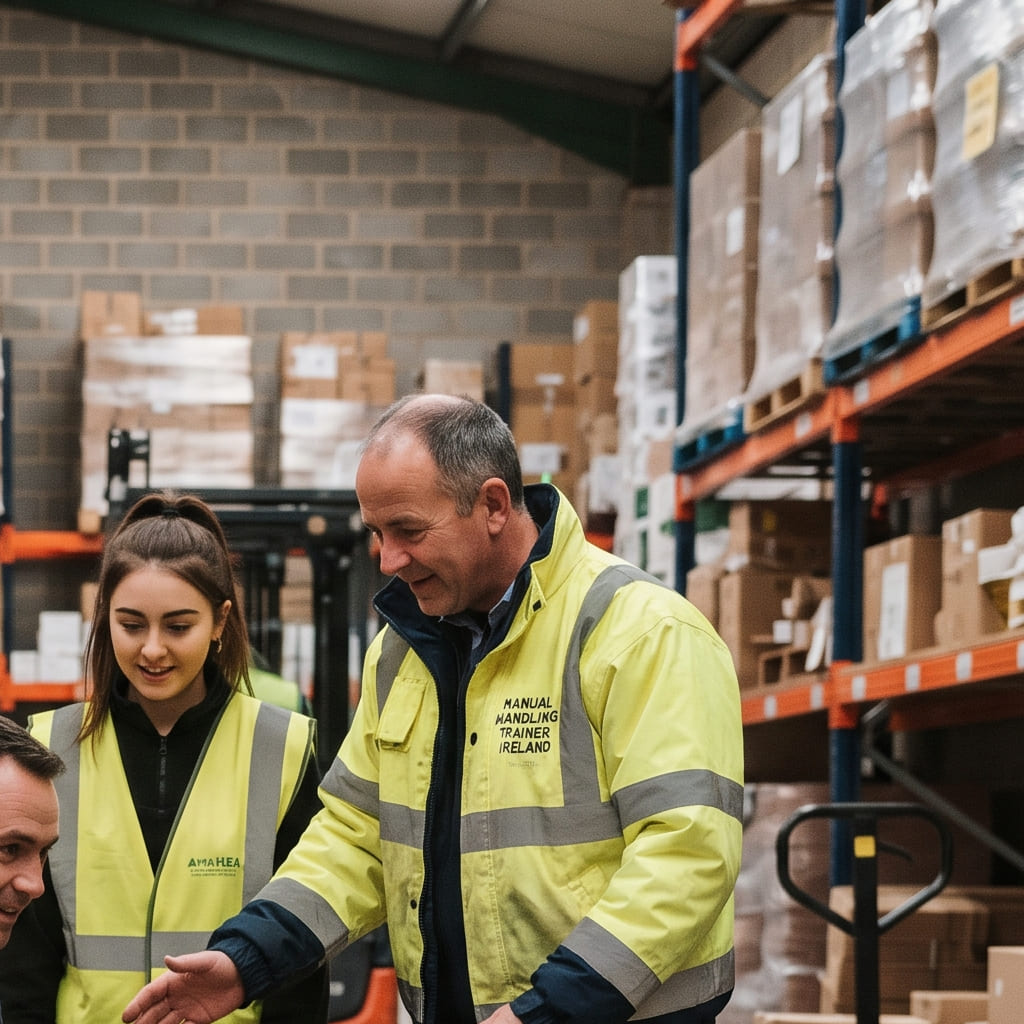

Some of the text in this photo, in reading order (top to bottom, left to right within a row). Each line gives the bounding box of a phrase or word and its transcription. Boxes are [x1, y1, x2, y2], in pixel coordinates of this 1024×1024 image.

[503, 696, 552, 710] MANUAL
[499, 726, 550, 739] TRAINER
[499, 740, 551, 754] IRELAND
